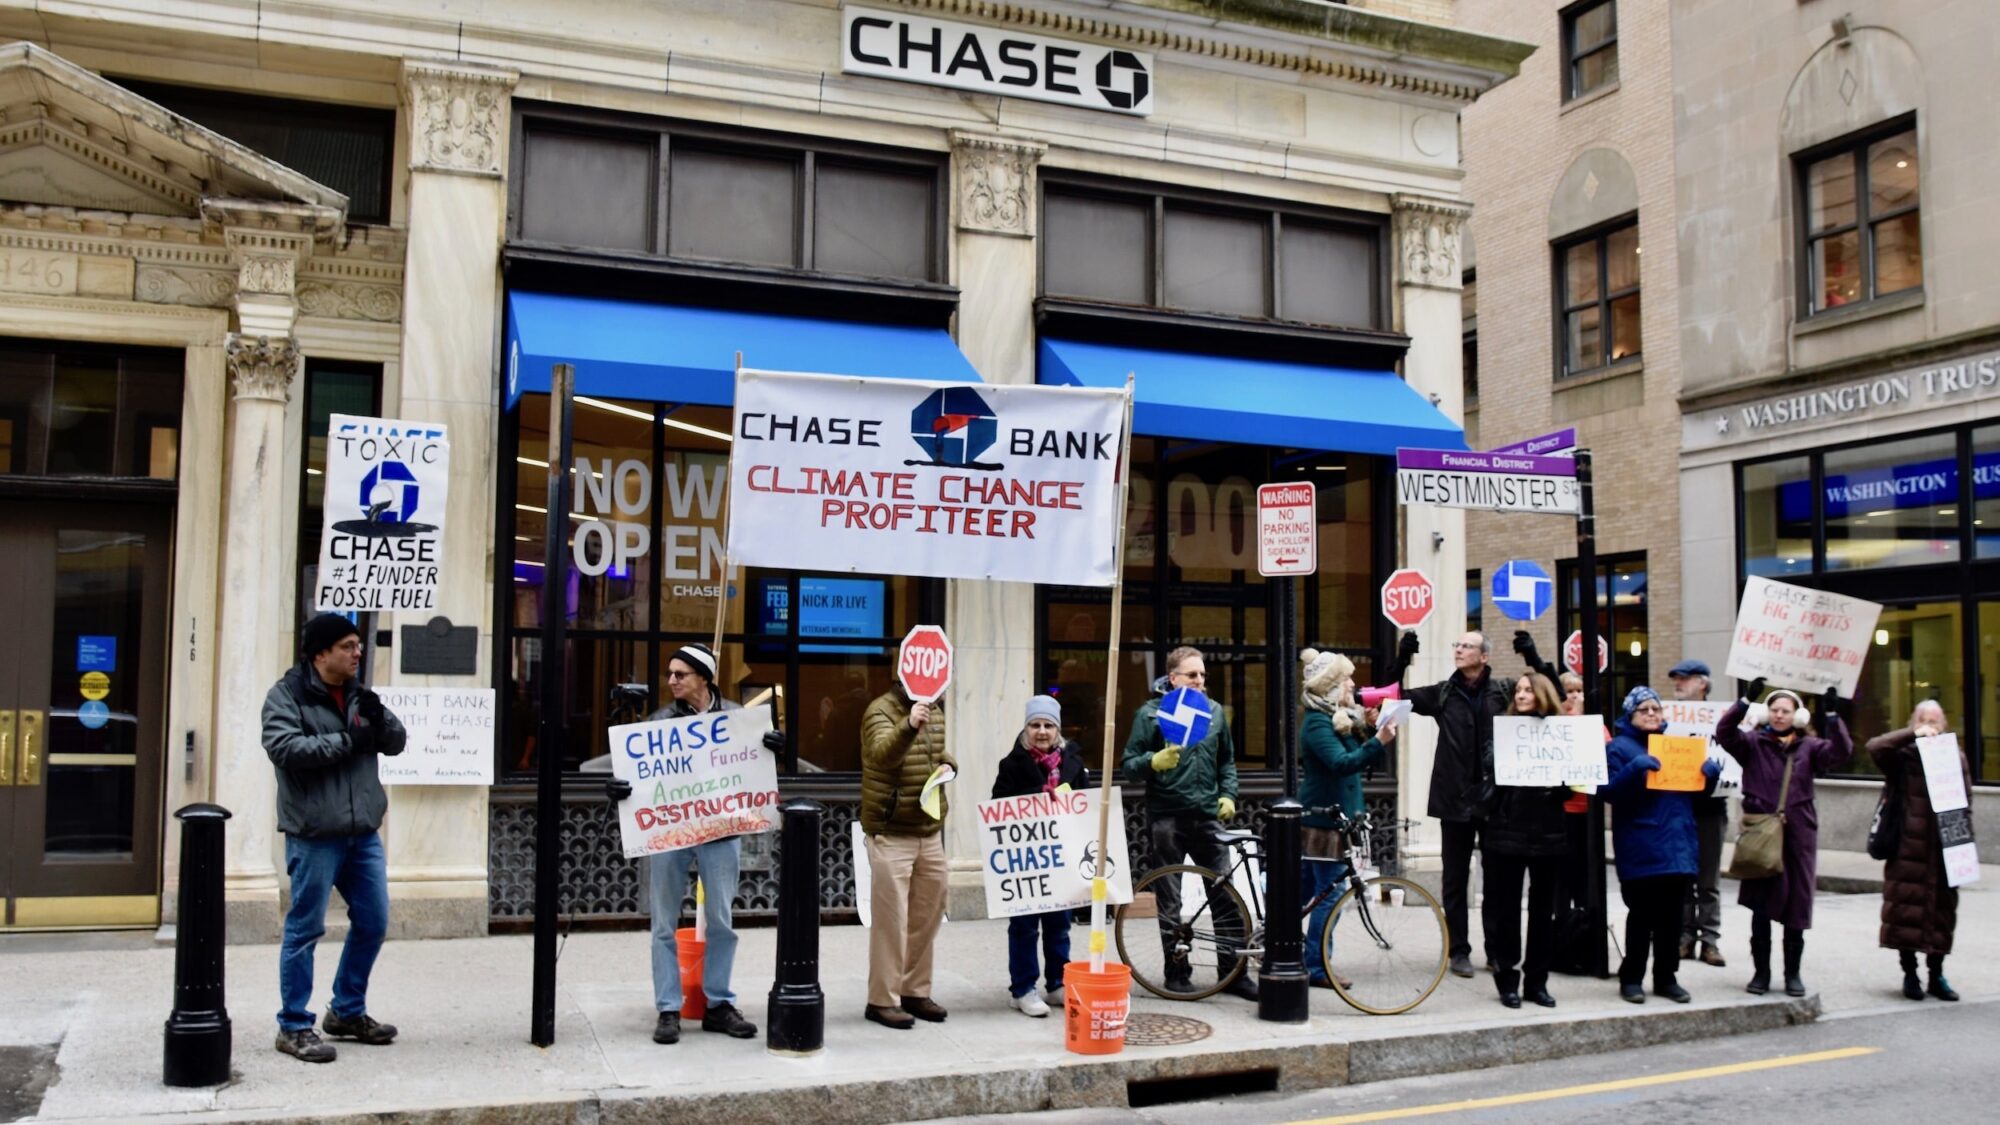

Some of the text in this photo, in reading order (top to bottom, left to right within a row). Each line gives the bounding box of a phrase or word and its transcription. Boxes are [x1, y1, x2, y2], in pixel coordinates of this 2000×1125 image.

[850, 16, 1081, 95] CHASE
[1741, 376, 1909, 428] WASHINGTON
[741, 412, 1112, 460] CHASE BANK
[337, 436, 439, 464] TOXIC
[574, 457, 727, 519] NOW
[747, 465, 1084, 510] CLIMATE CHANGE
[1262, 489, 1310, 504] WARNING
[1400, 473, 1558, 507] WESTMINSTER
[1826, 472, 1947, 503] WASHINGTON
[821, 499, 1036, 540] PROFITEER
[1278, 509, 1294, 520] NO
[1264, 522, 1309, 534] PARKING
[1264, 536, 1310, 545] ON HOLLOW
[330, 536, 436, 562] CHASE
[573, 520, 737, 580] OPEN
[1268, 547, 1306, 555] SIDEWALK
[331, 564, 438, 585] #1 FUNDER
[320, 586, 434, 609] FOSSIL FUEL
[673, 585, 722, 597] CHASE
[767, 591, 788, 607] FEB
[802, 594, 868, 609] NICK JR LIVE
[1386, 585, 1431, 611] STOP
[1738, 625, 1783, 650] DEATH
[903, 645, 948, 679] STOP
[444, 695, 489, 709] BANK
[403, 715, 492, 728] ITH CHASE
[1516, 724, 1574, 742] CHASE
[625, 715, 730, 759] CHASE
[638, 746, 758, 779] BANK Funds
[1516, 745, 1574, 761] FUNDS
[652, 773, 742, 805] Amazon
[634, 790, 782, 831] DESTRUCTION
[978, 792, 1088, 824] WARNING
[990, 820, 1059, 844] TOXIC
[990, 844, 1065, 874] CHASE
[1001, 874, 1051, 901] SITE
